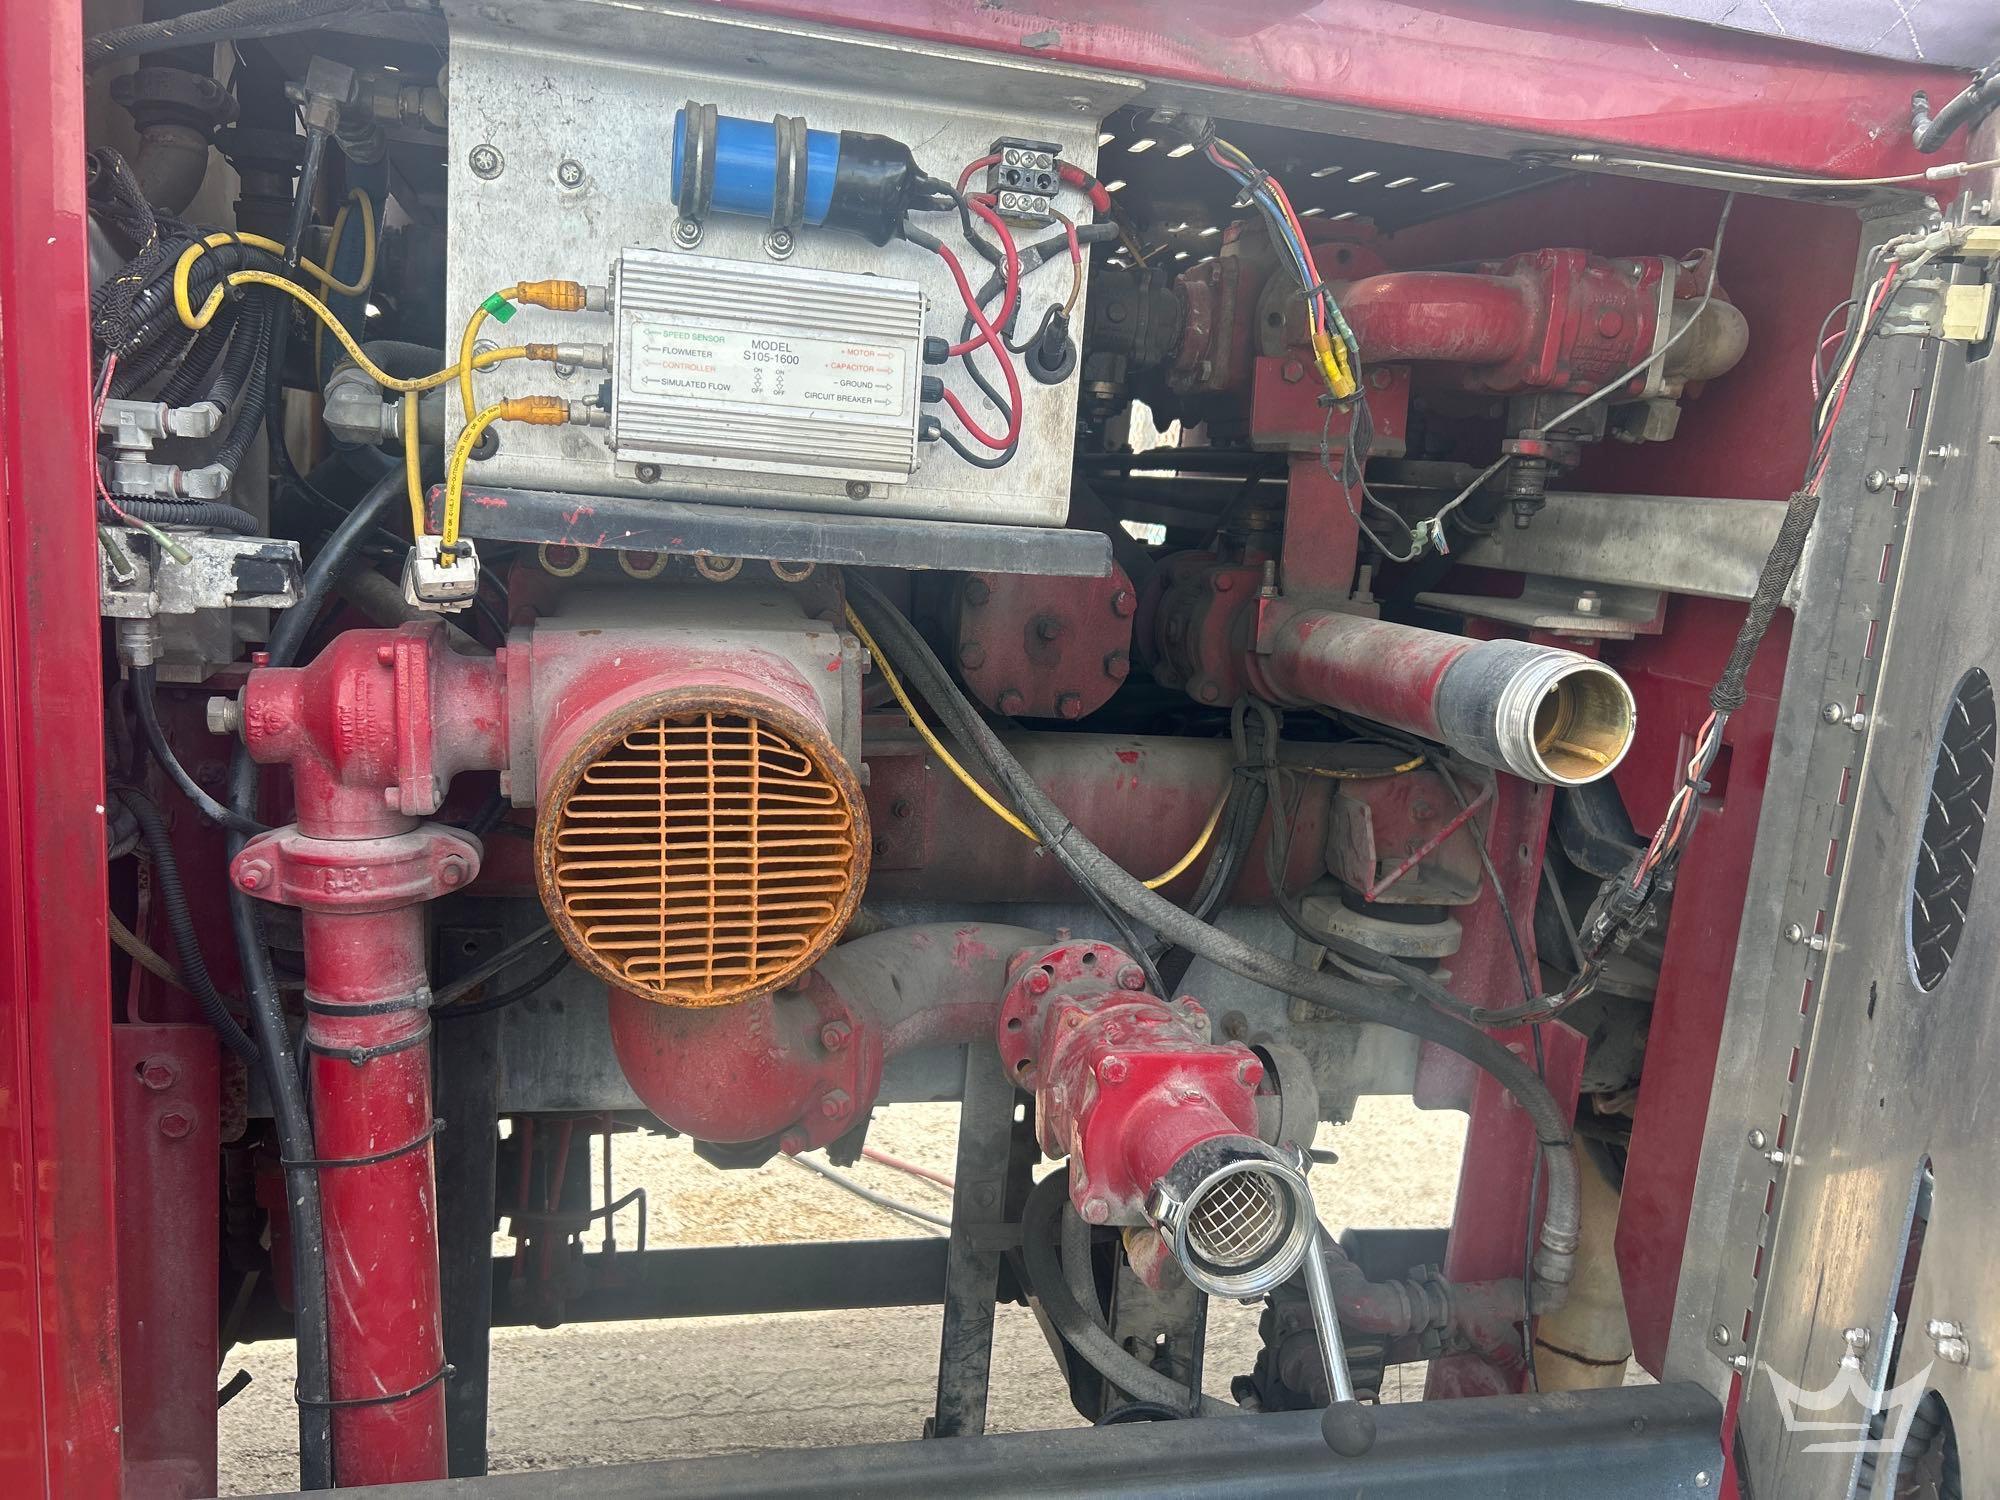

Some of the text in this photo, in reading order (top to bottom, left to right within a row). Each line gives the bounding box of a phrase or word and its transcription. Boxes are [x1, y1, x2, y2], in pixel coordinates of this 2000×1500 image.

[663, 330, 726, 343] SPEED SENSOR
[662, 346, 713, 358] FLOWMETER
[751, 340, 792, 353] MODEL
[847, 348, 875, 357] MOTOR
[743, 351, 800, 365] S105-1600
[662, 361, 716, 373] CONTROLLER
[830, 362, 874, 372] CAPACITOR
[661, 378, 731, 391] SIMULATED FLOW
[840, 379, 873, 389] GROUND
[804, 391, 873, 404] CIRCUIT BREAKER
